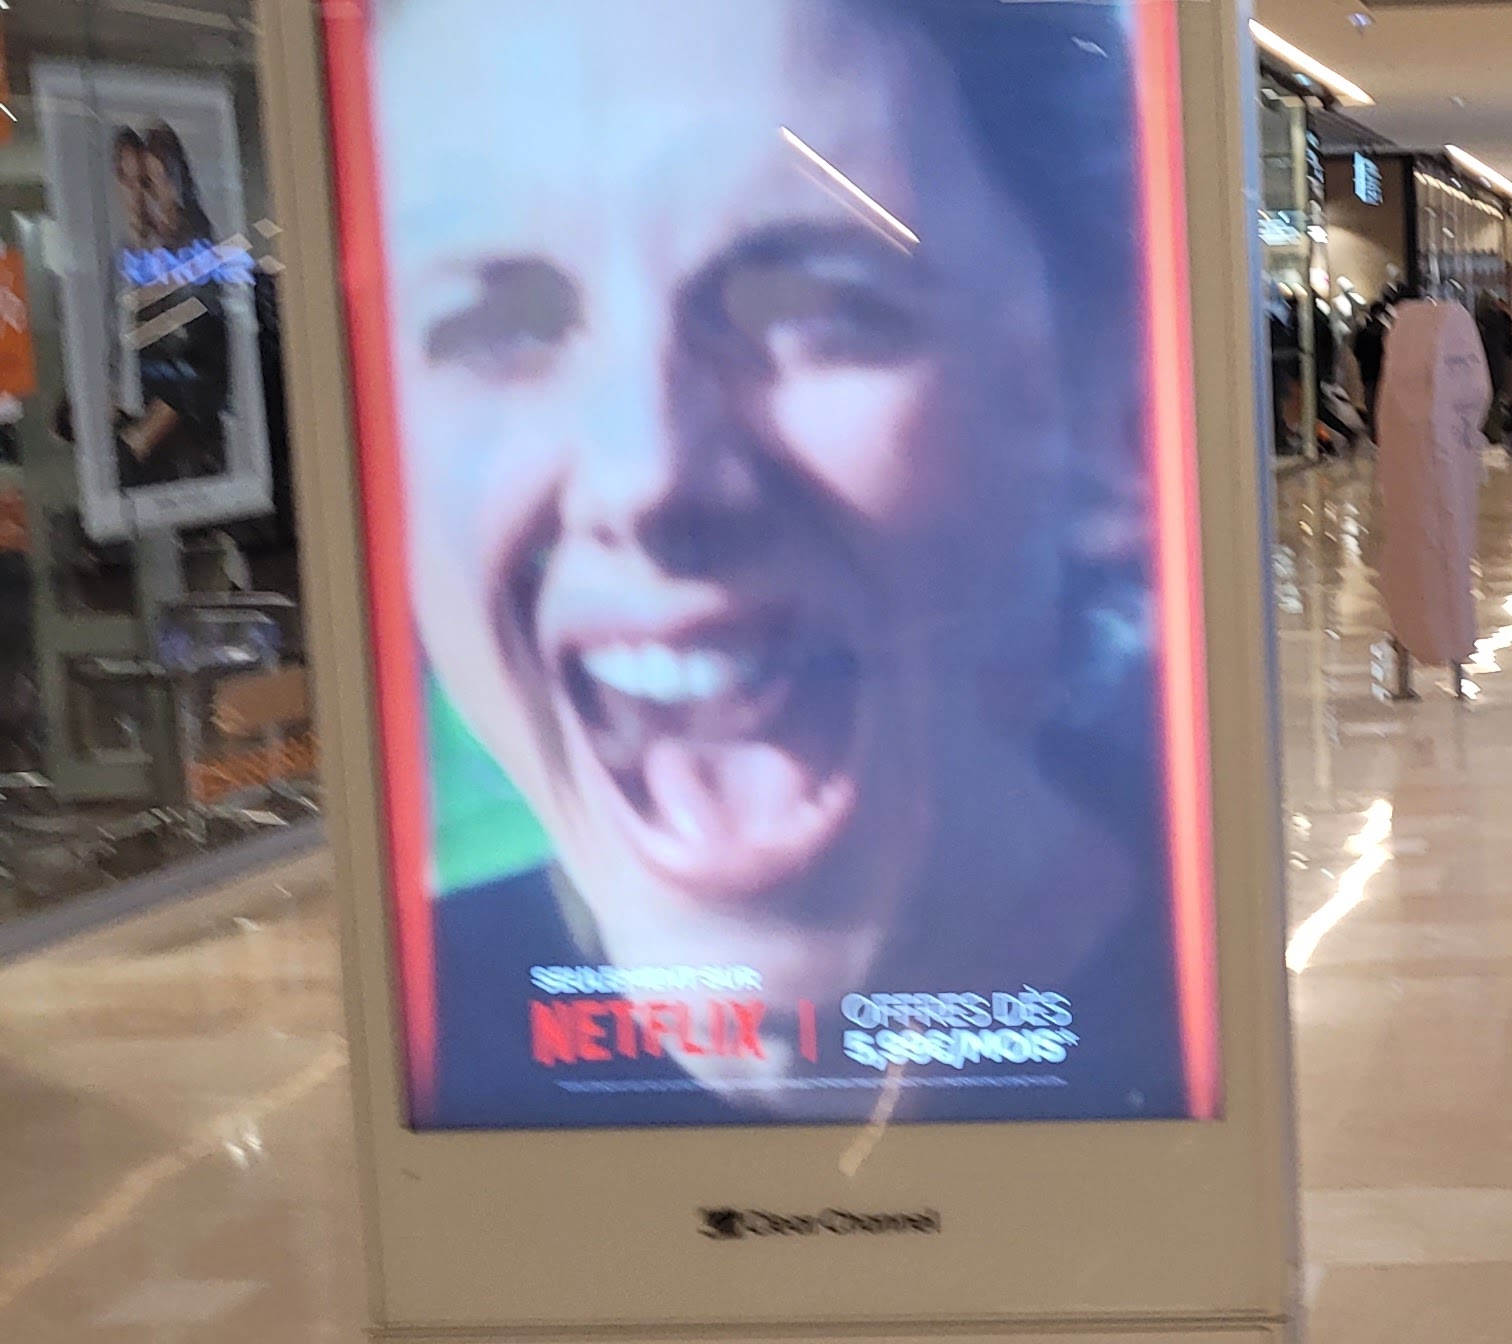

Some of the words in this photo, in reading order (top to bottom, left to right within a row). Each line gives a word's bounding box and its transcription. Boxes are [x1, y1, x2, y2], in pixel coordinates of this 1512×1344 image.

[528, 997, 767, 1067] NETFLIX
[840, 991, 992, 1029] OFFRES
[991, 984, 1073, 1027] DÈS
